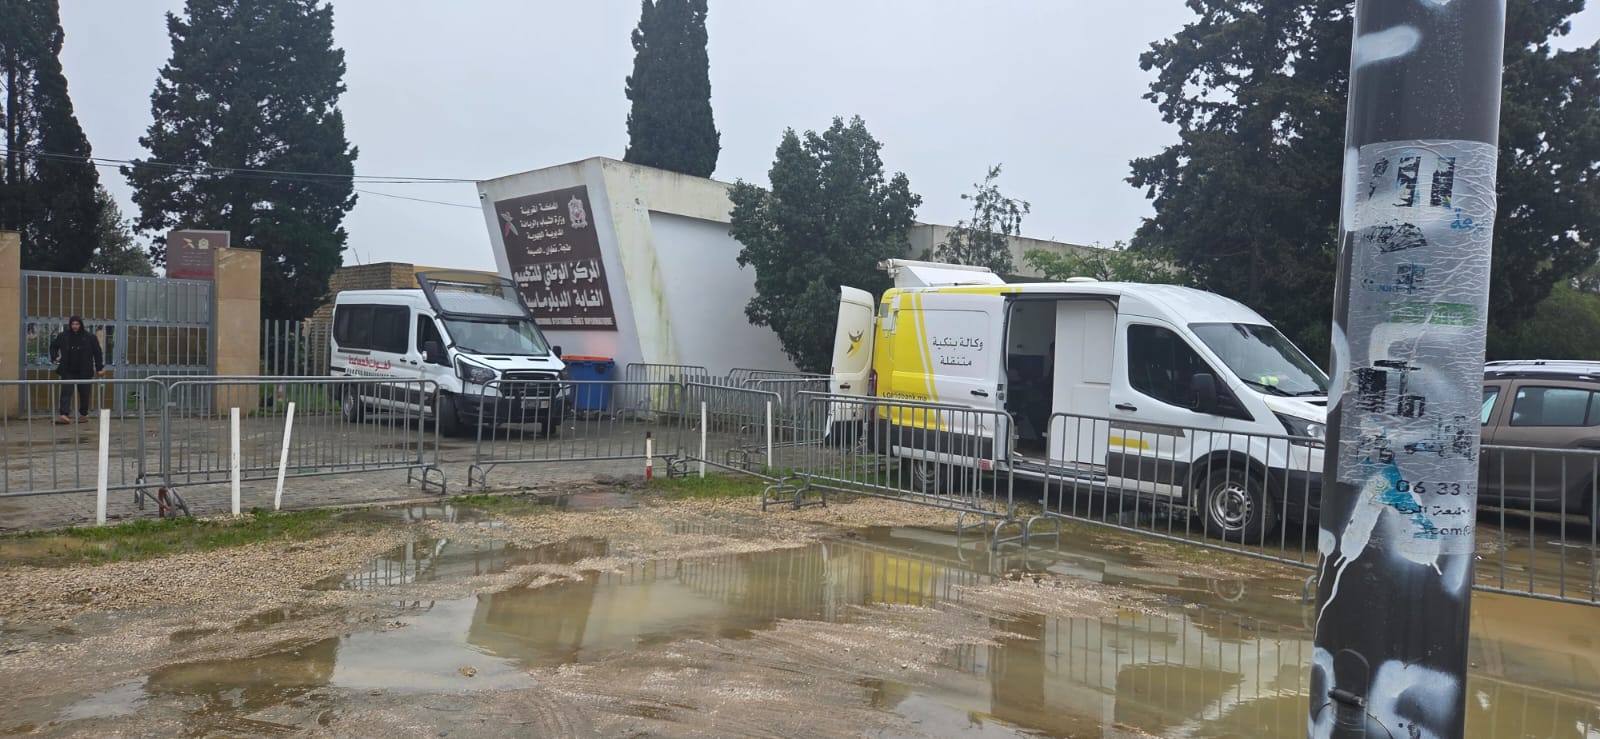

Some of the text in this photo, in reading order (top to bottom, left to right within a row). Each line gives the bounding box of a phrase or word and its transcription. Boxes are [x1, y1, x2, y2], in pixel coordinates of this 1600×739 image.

[519, 201, 559, 216] المملكة المغربية
[543, 262, 569, 290] الوطني
[570, 259, 600, 284] المركز
[572, 288, 604, 312] الغابة
[932, 335, 984, 351] وكالة بنكية
[939, 355, 972, 366] متنقلة
[1396, 479, 1426, 494] 06
[1437, 481, 1460, 496] 33
